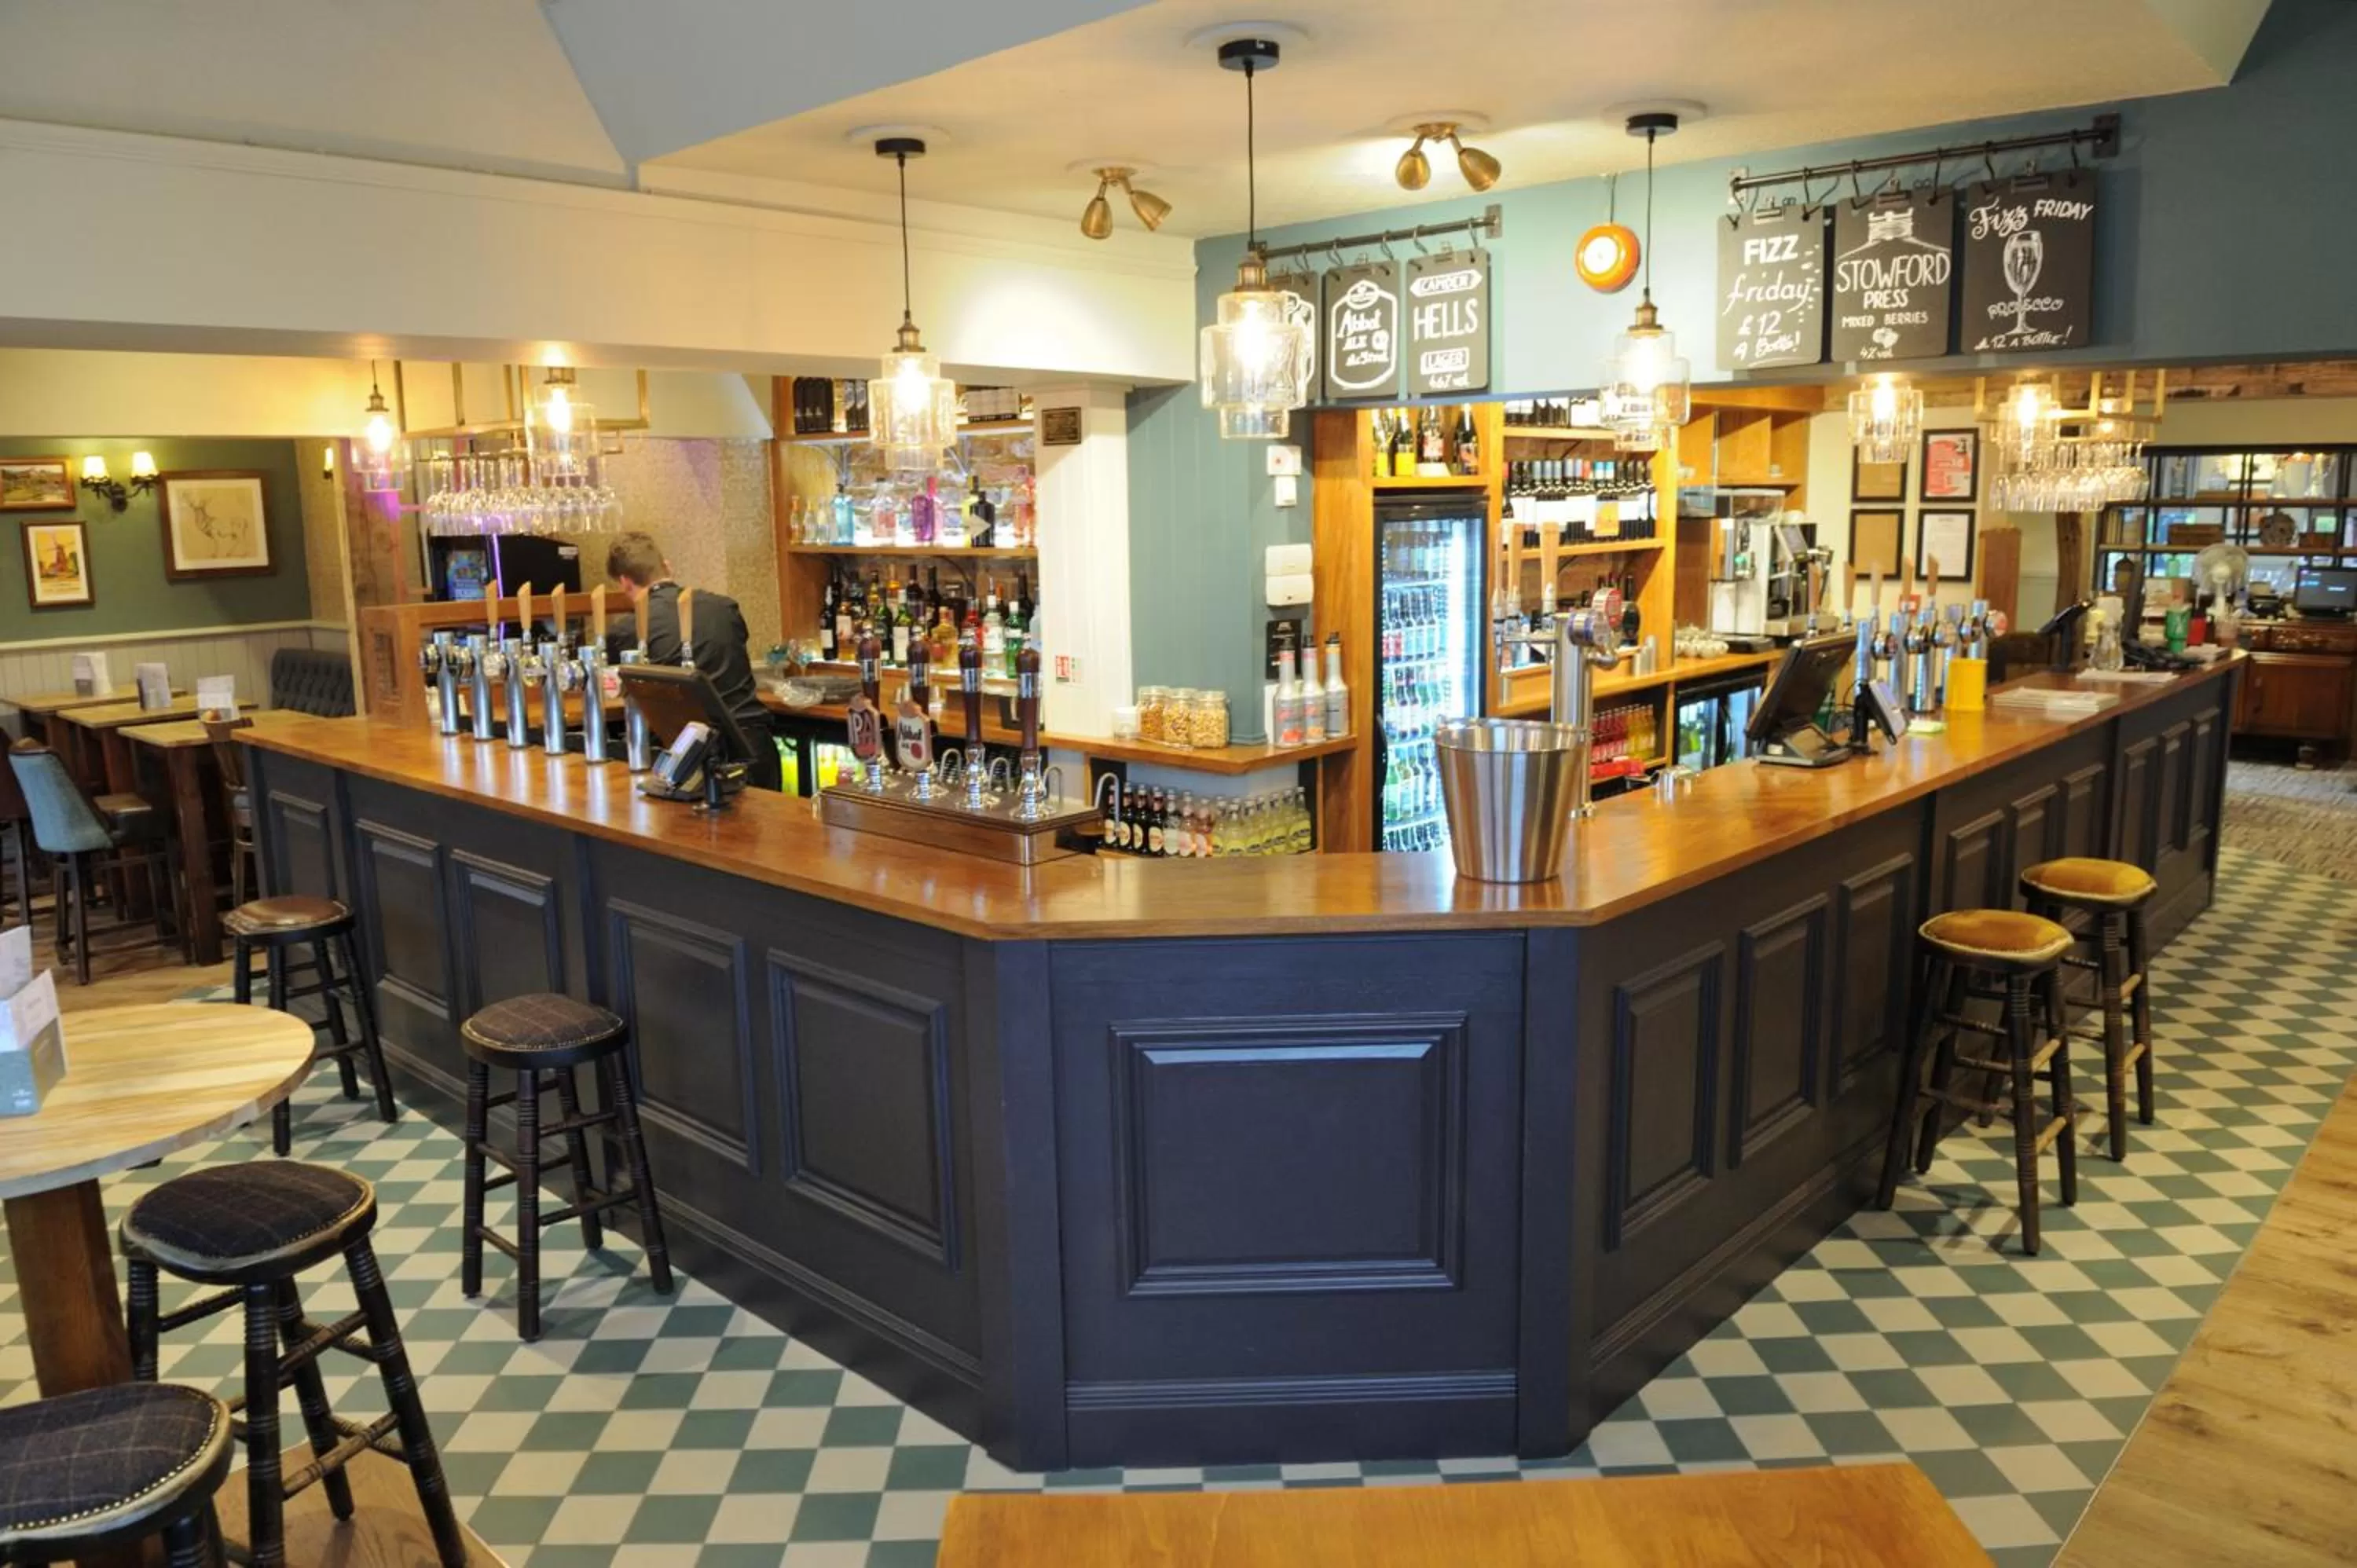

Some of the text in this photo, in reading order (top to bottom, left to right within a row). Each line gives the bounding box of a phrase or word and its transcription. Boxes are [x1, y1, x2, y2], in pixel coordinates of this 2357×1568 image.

[1968, 197, 2094, 240] Fizz FRIDAY
[1743, 234, 1800, 266] FIZZ
[1835, 253, 1951, 293] STOWFORD
[1863, 288, 1909, 310] PRESS
[1413, 298, 1479, 343] HELLS
[1841, 311, 1929, 328] MIXED BERRIES
